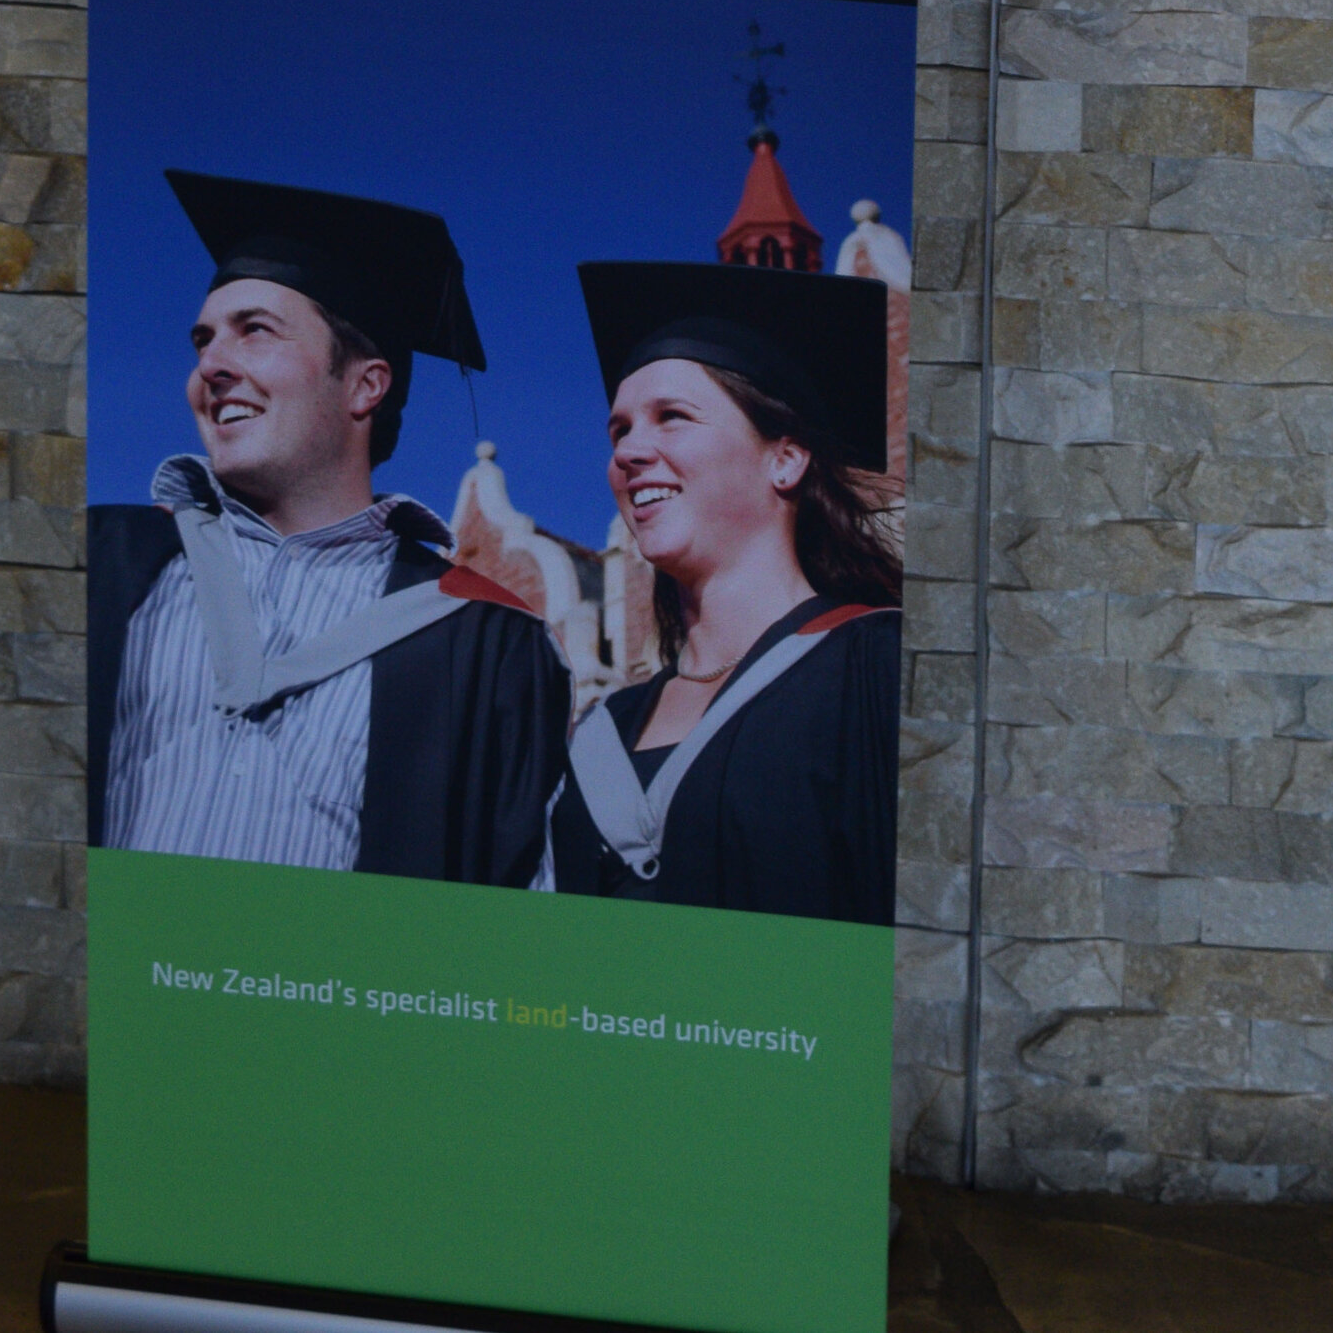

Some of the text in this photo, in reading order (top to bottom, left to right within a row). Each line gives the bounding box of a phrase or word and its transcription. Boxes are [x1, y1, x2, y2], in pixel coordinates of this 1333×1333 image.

[152, 961, 214, 991] New
[222, 969, 357, 1007] Zealand's
[366, 989, 498, 1022] specialist
[675, 1020, 818, 1061] university
